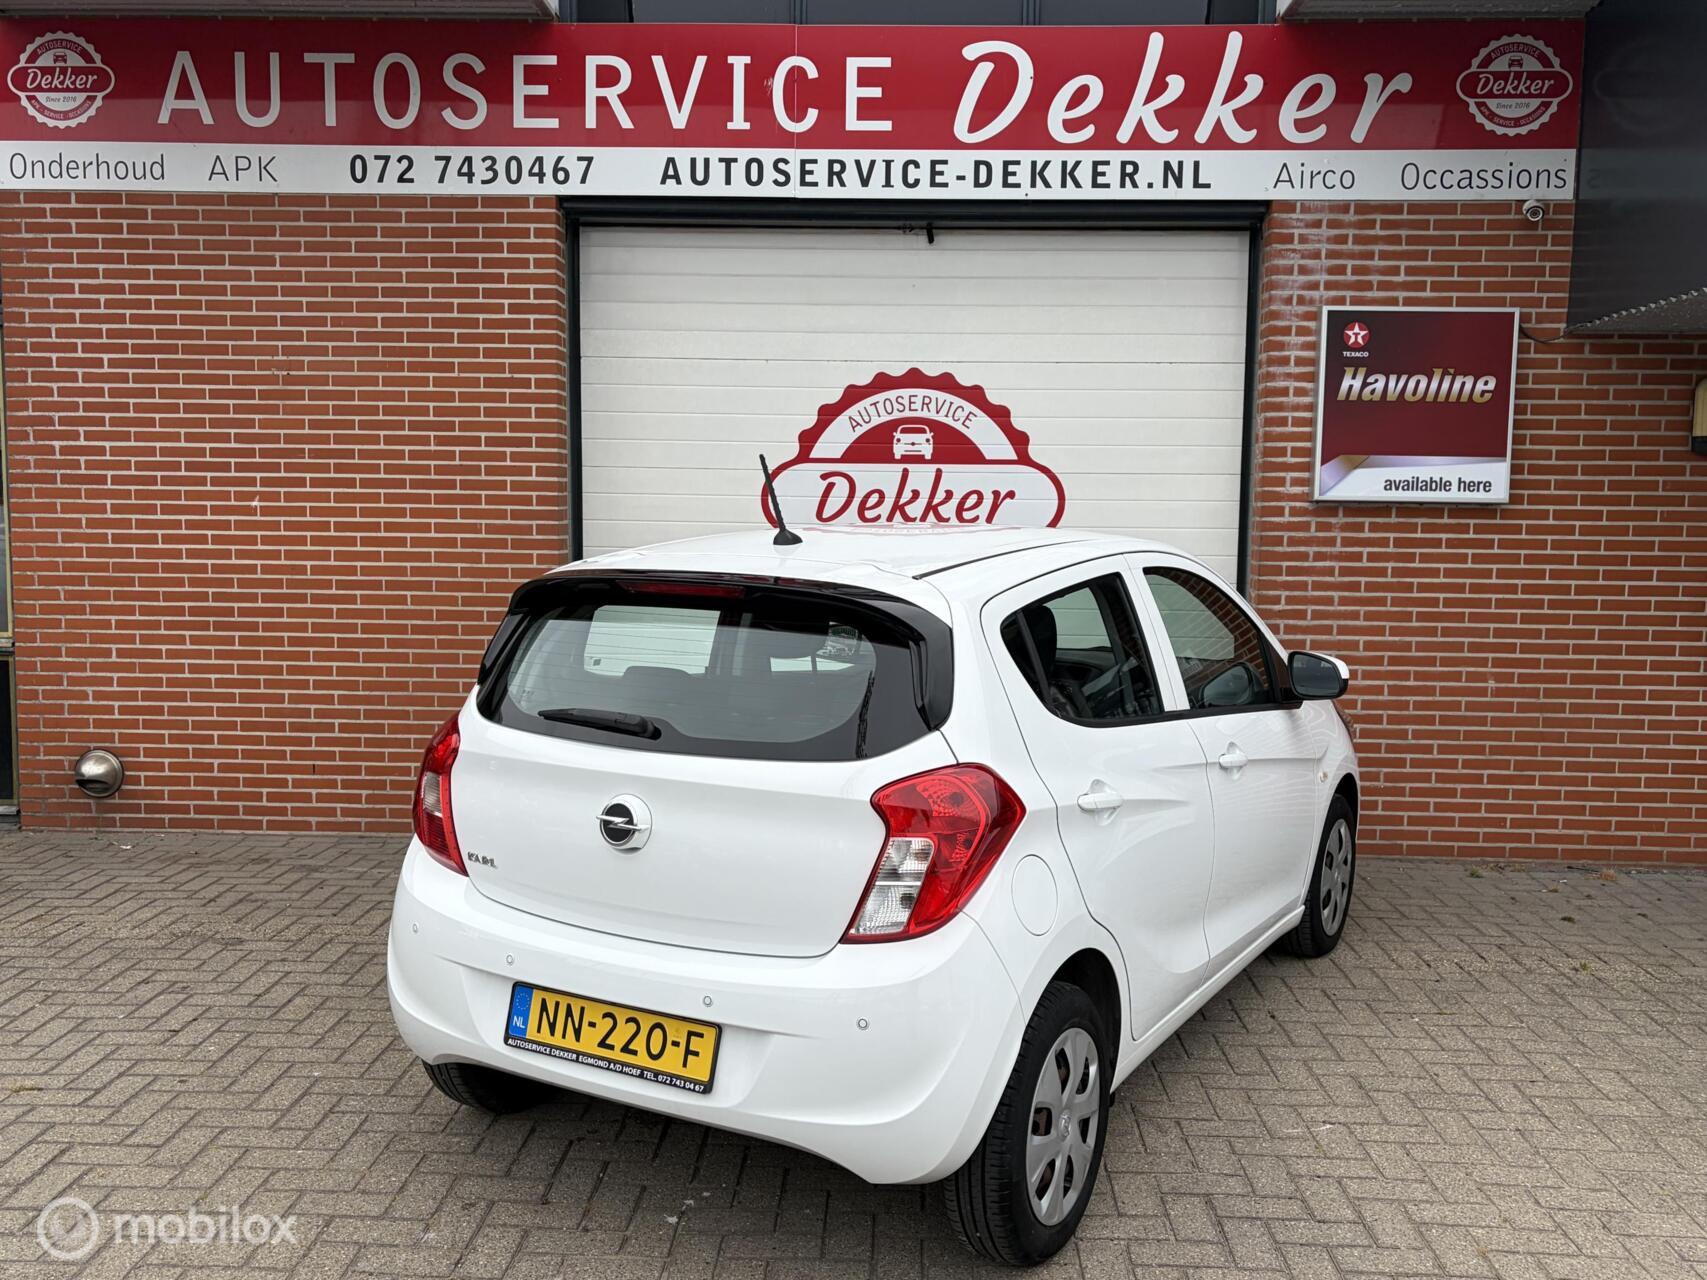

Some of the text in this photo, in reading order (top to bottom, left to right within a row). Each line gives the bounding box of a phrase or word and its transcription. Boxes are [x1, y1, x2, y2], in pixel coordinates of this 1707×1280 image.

[37, 40, 82, 55] AUTOSERVICE
[1490, 43, 1541, 59] AUTOSERVICE
[26, 67, 98, 89] Dekker
[157, 31, 1413, 145] AUTOSERVICE Dekker
[1476, 71, 1555, 95] Dekker
[9, 152, 166, 181] Onderhoud
[208, 155, 279, 182] APK
[349, 154, 594, 185] 072 7430467
[660, 156, 1212, 189] AUTOSERVICE-DEKKER.NL
[1273, 163, 1356, 190] Airco
[1401, 162, 1568, 190] Occassions
[1336, 367, 1497, 403] Havoline
[848, 394, 978, 432] AUTOSERVICE
[815, 467, 1016, 524] Dekker
[1383, 476, 1492, 493] available here
[512, 1015, 526, 1029] NL
[536, 997, 705, 1069] NN-220-F
[507, 1038, 550, 1055] AUTOSERVICE
[551, 1048, 577, 1060] DEKKER
[578, 1055, 609, 1069] EGMOND
[609, 1062, 622, 1072] A/D
[622, 1066, 641, 1076] HOEF
[643, 1071, 657, 1081] TEL.
[657, 1075, 671, 1084] 072
[671, 1078, 684, 1088] 743
[685, 1082, 694, 1090] 04
